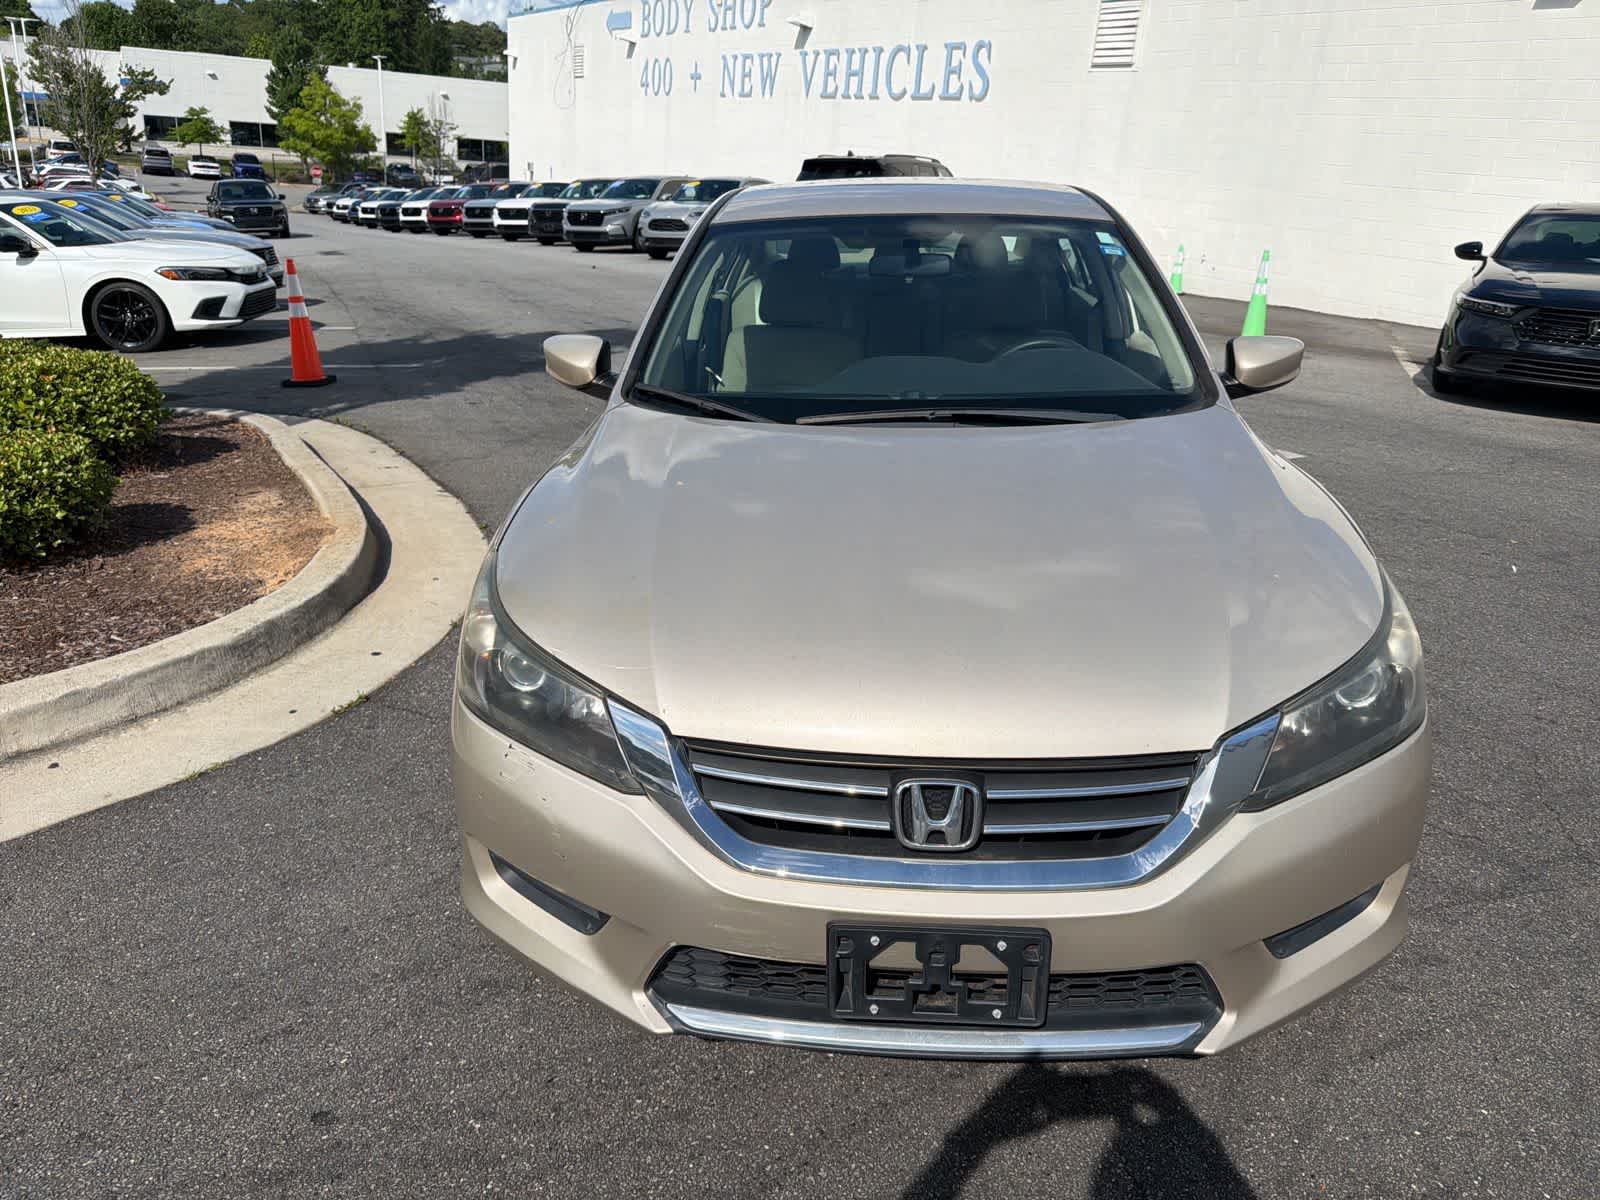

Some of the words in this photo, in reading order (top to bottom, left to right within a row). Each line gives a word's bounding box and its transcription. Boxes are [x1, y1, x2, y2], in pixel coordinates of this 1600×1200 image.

[640, 0, 694, 38] BODY
[708, 0, 772, 32] SHOP
[640, 57, 673, 97] 400
[719, 52, 782, 98] NEW
[799, 39, 993, 103] VEHICLES
